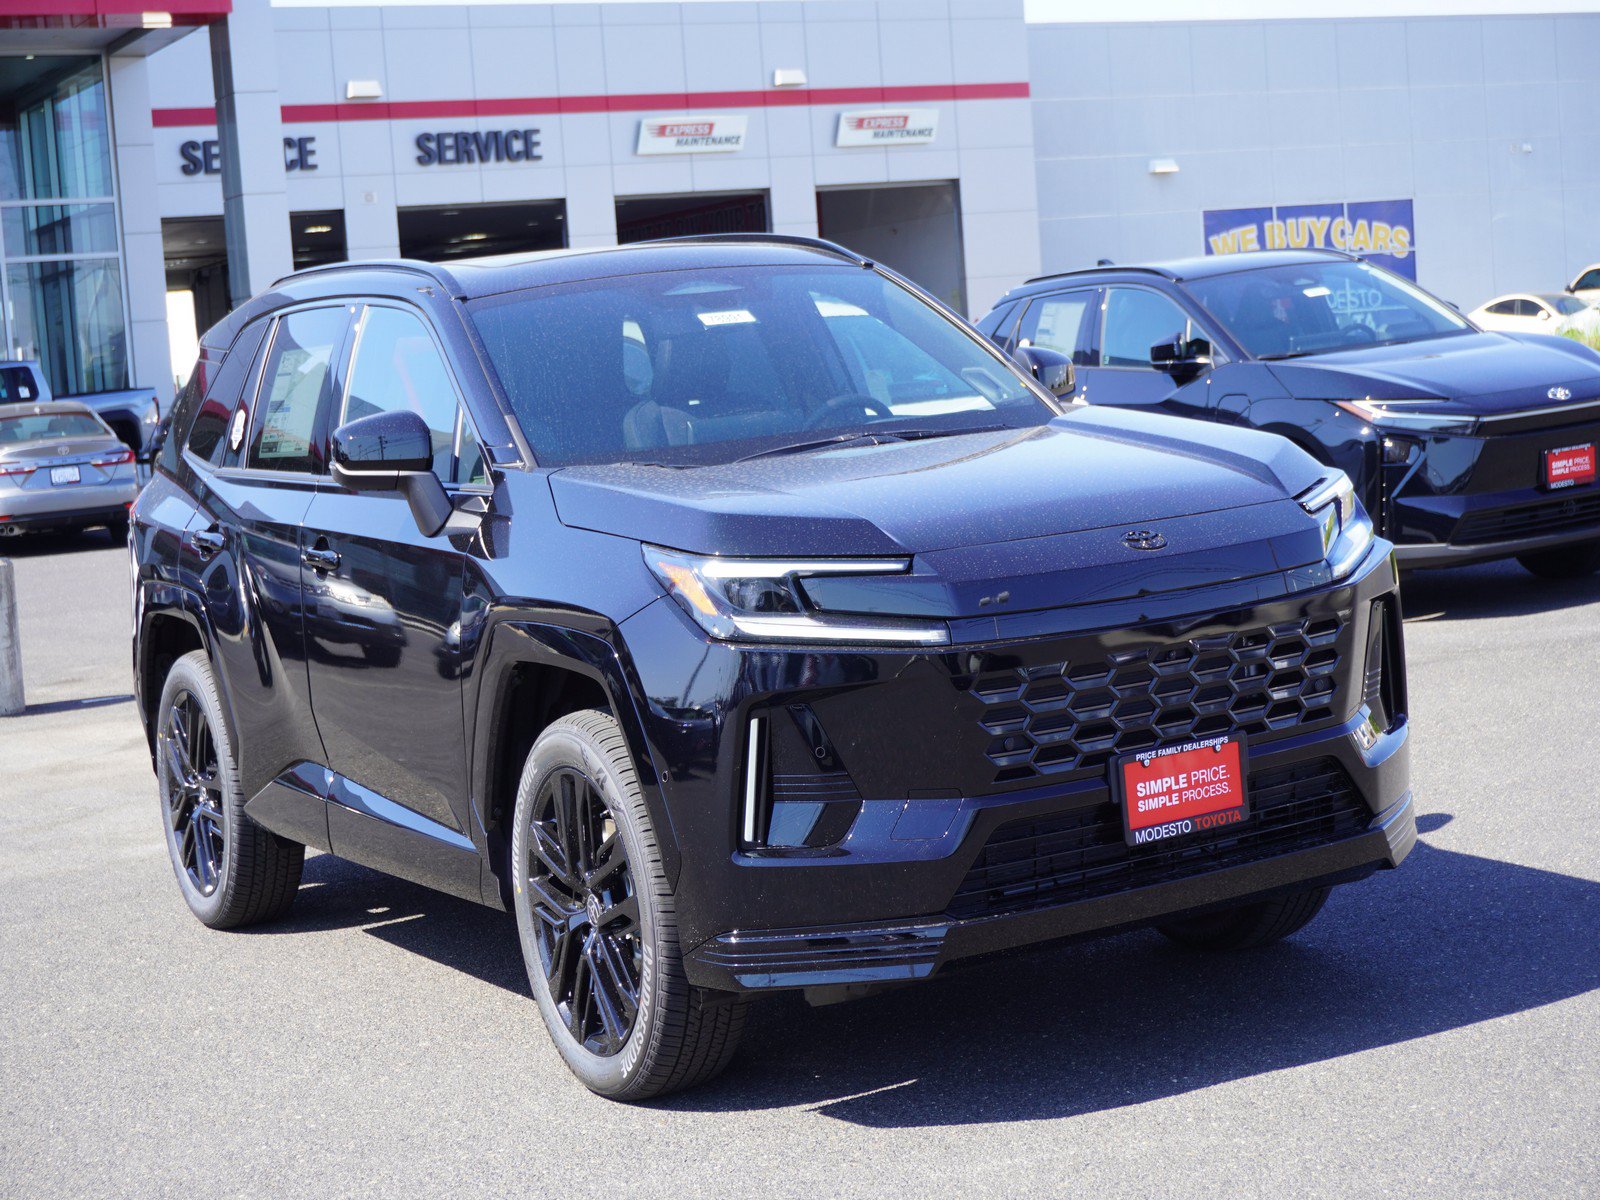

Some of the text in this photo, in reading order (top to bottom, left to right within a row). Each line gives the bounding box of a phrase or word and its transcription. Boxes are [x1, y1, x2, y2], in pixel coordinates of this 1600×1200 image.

[665, 123, 711, 136] EXPRESS
[863, 116, 905, 129] EXPRESS
[872, 127, 934, 139] MAINTENANCE
[415, 129, 543, 167] SERVICE
[675, 135, 742, 147] MAINTENANCE
[1208, 216, 1411, 259] WE BUY CARS
[1551, 479, 1574, 489] MODESTO
[1135, 735, 1229, 761] PRICE FAMILY DEALERSHIPS
[1136, 765, 1231, 797] SIMPLE PRICE.
[1137, 781, 1232, 812] SIMPLE PROCESS.
[1135, 810, 1242, 844] MODESTO TOYOTA
